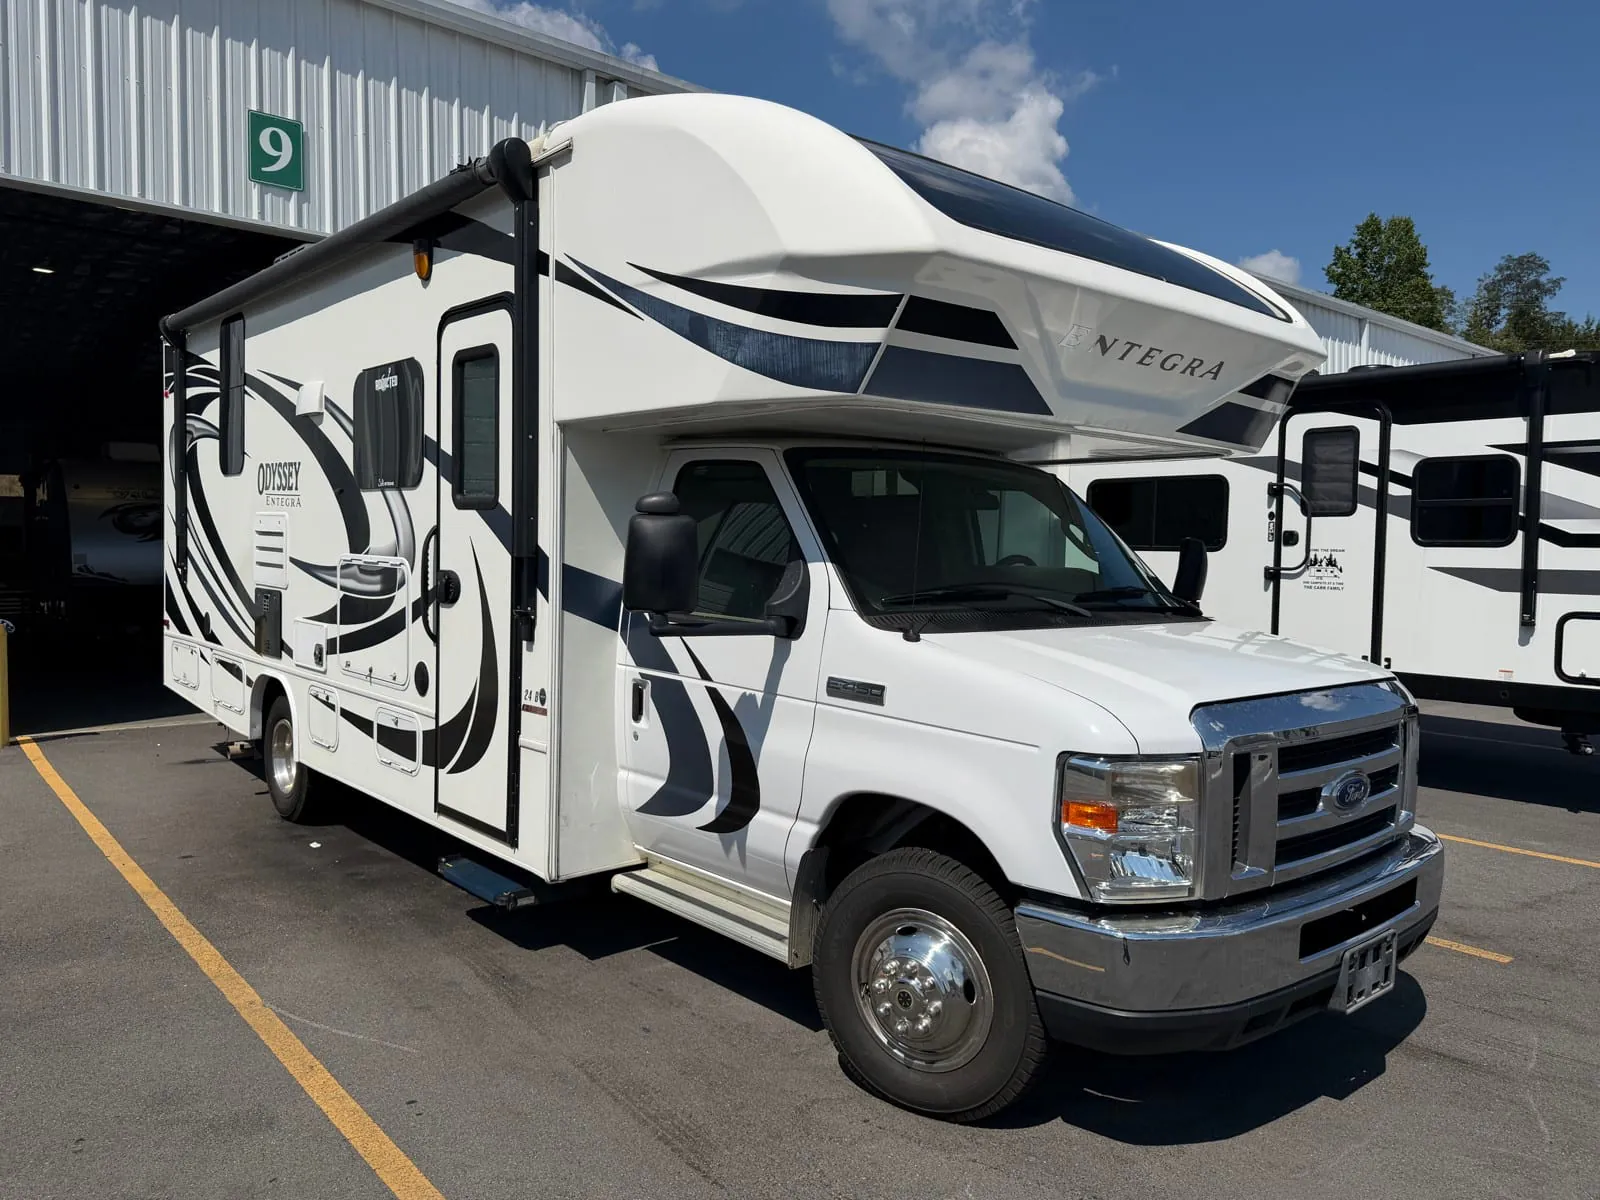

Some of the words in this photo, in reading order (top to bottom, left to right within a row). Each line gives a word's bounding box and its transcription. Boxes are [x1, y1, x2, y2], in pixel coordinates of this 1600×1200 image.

[259, 127, 293, 172] 9
[1058, 324, 1225, 380] ENTEGRA
[257, 461, 301, 495] ODYSSEY
[266, 496, 301, 507] ENTEGRA
[1345, 783, 1364, 802] Ford
